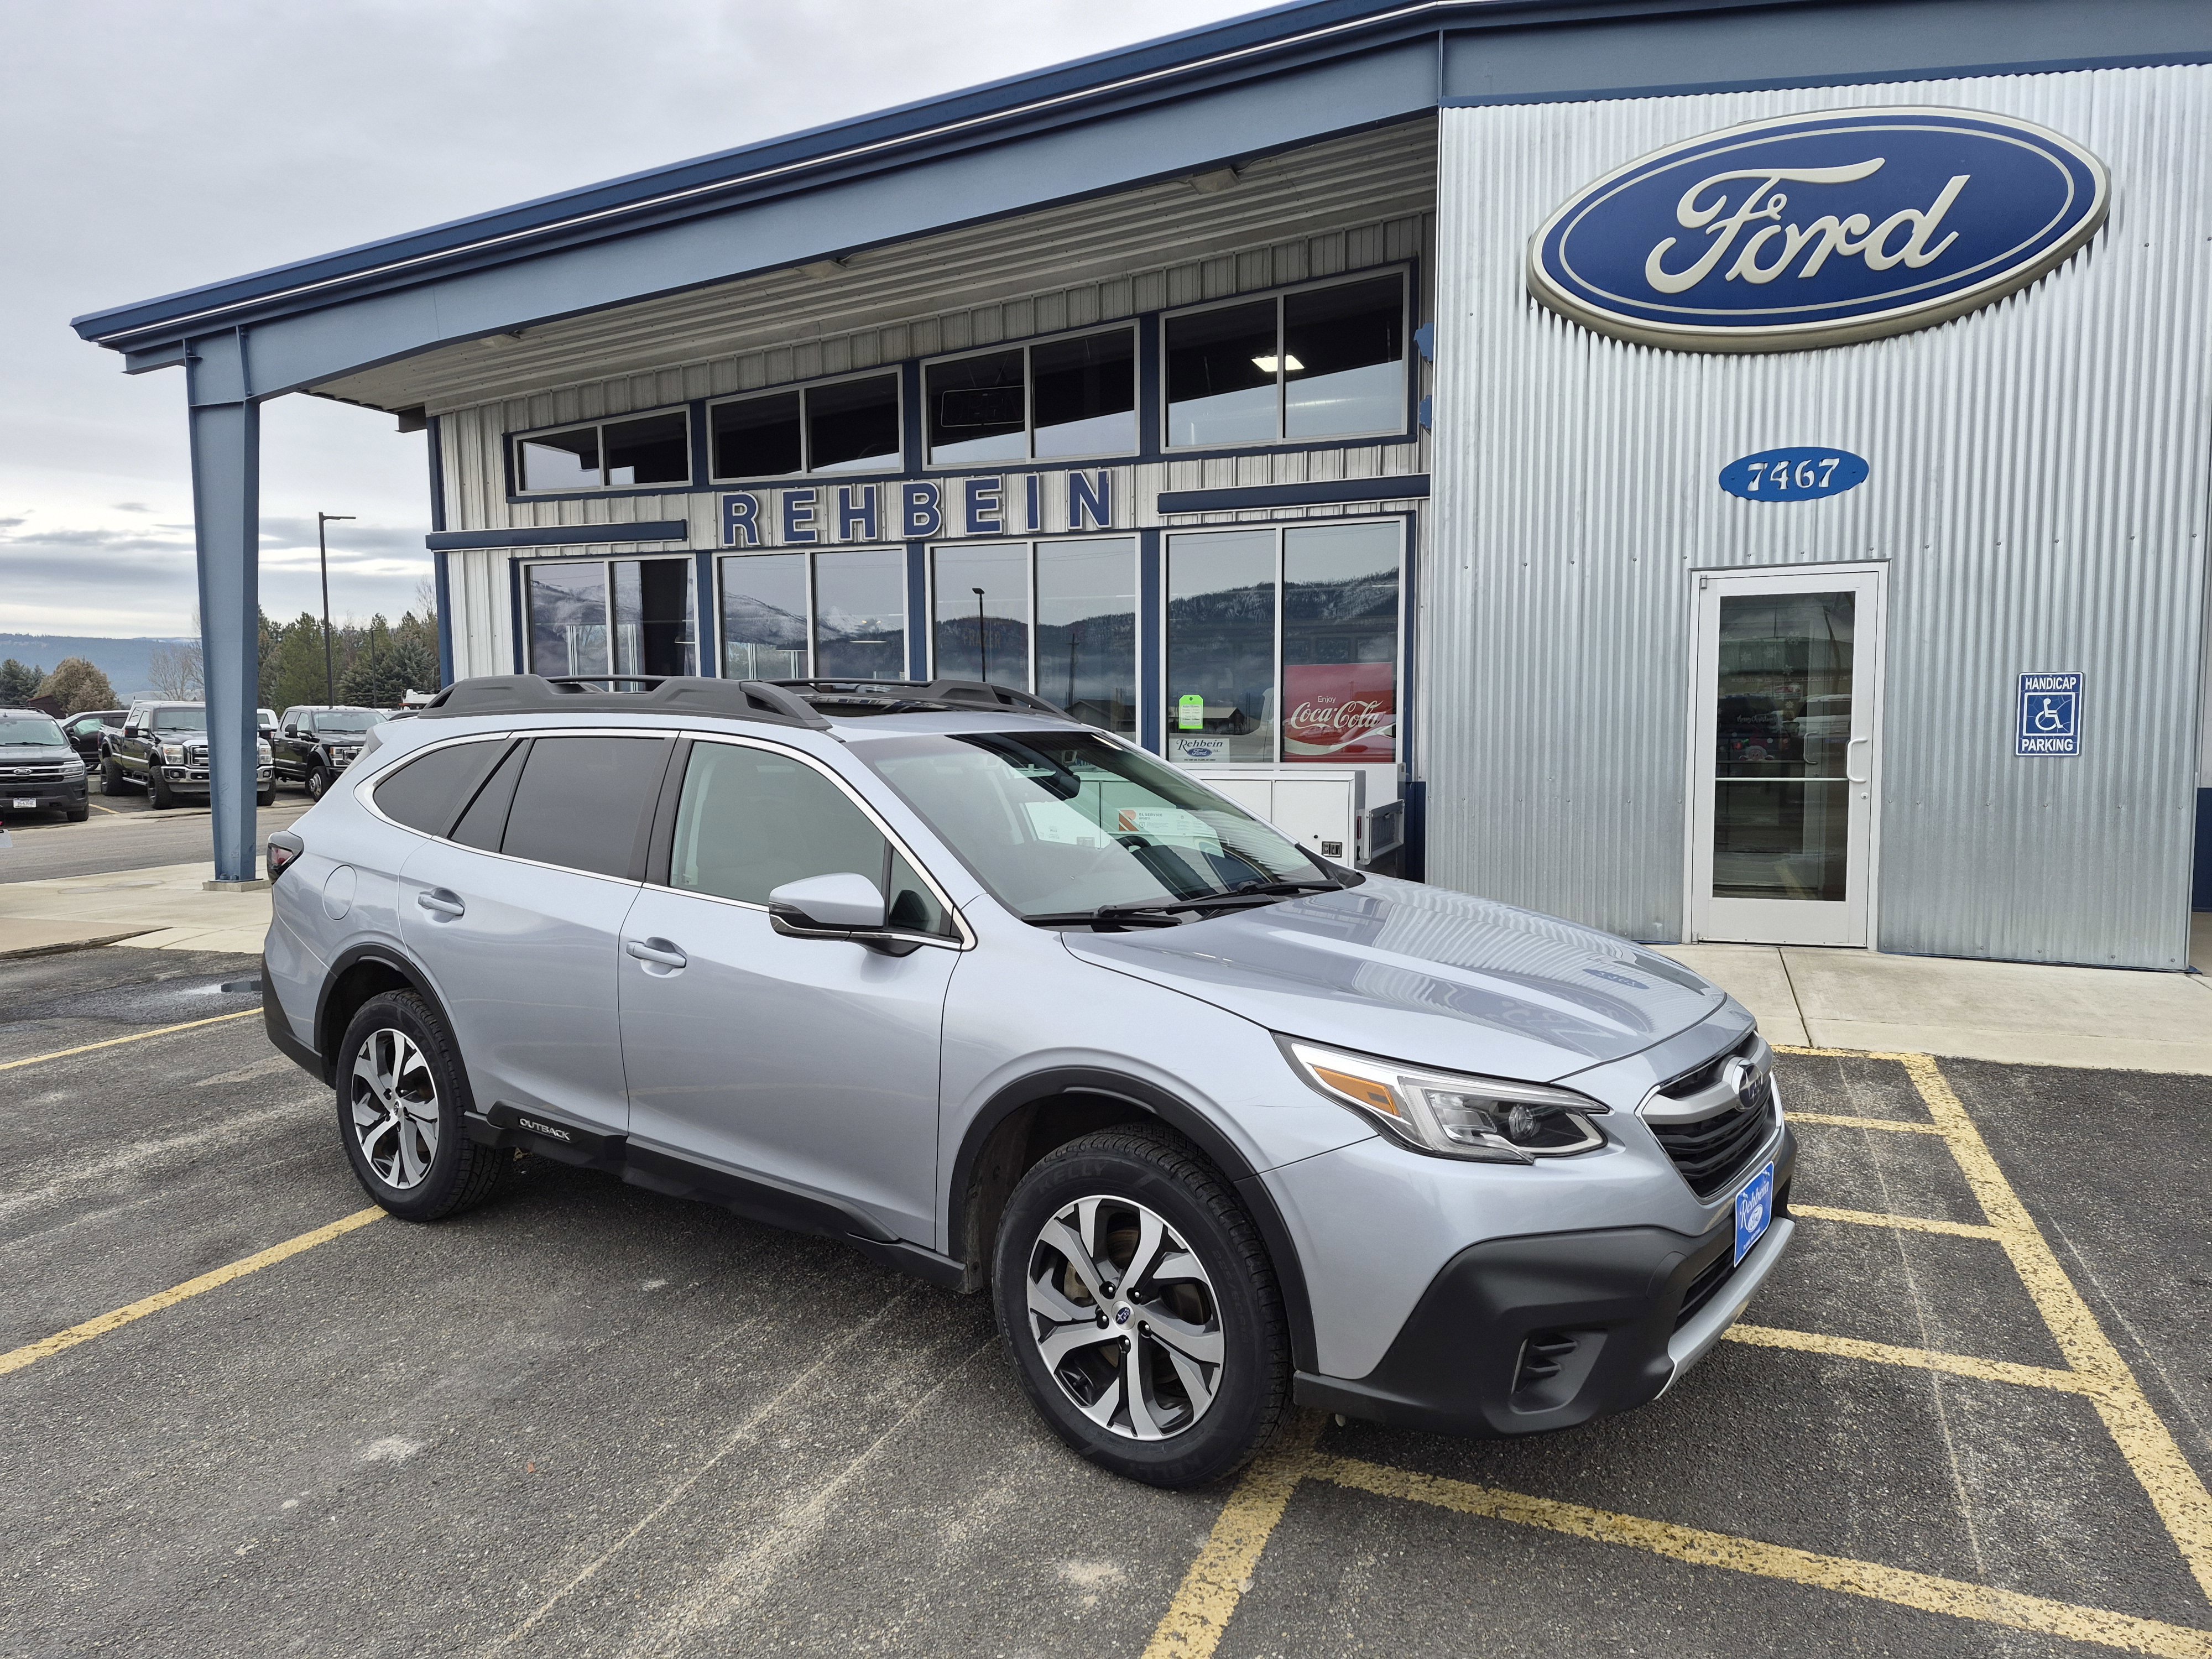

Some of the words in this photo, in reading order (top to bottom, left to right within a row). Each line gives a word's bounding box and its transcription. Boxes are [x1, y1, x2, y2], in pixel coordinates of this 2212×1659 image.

[1645, 157, 1970, 294] Ford
[1746, 458, 1840, 491] 7467
[721, 468, 1112, 547] REHBEIN
[2025, 677, 2077, 690] HANDICAP
[1291, 700, 1384, 729] Coca-Cola
[1176, 739, 1223, 753] Rehbein
[2022, 738, 2073, 751] PARKING
[519, 1118, 570, 1140] OUTBACK
[1740, 1181, 1770, 1230] Rehbein
